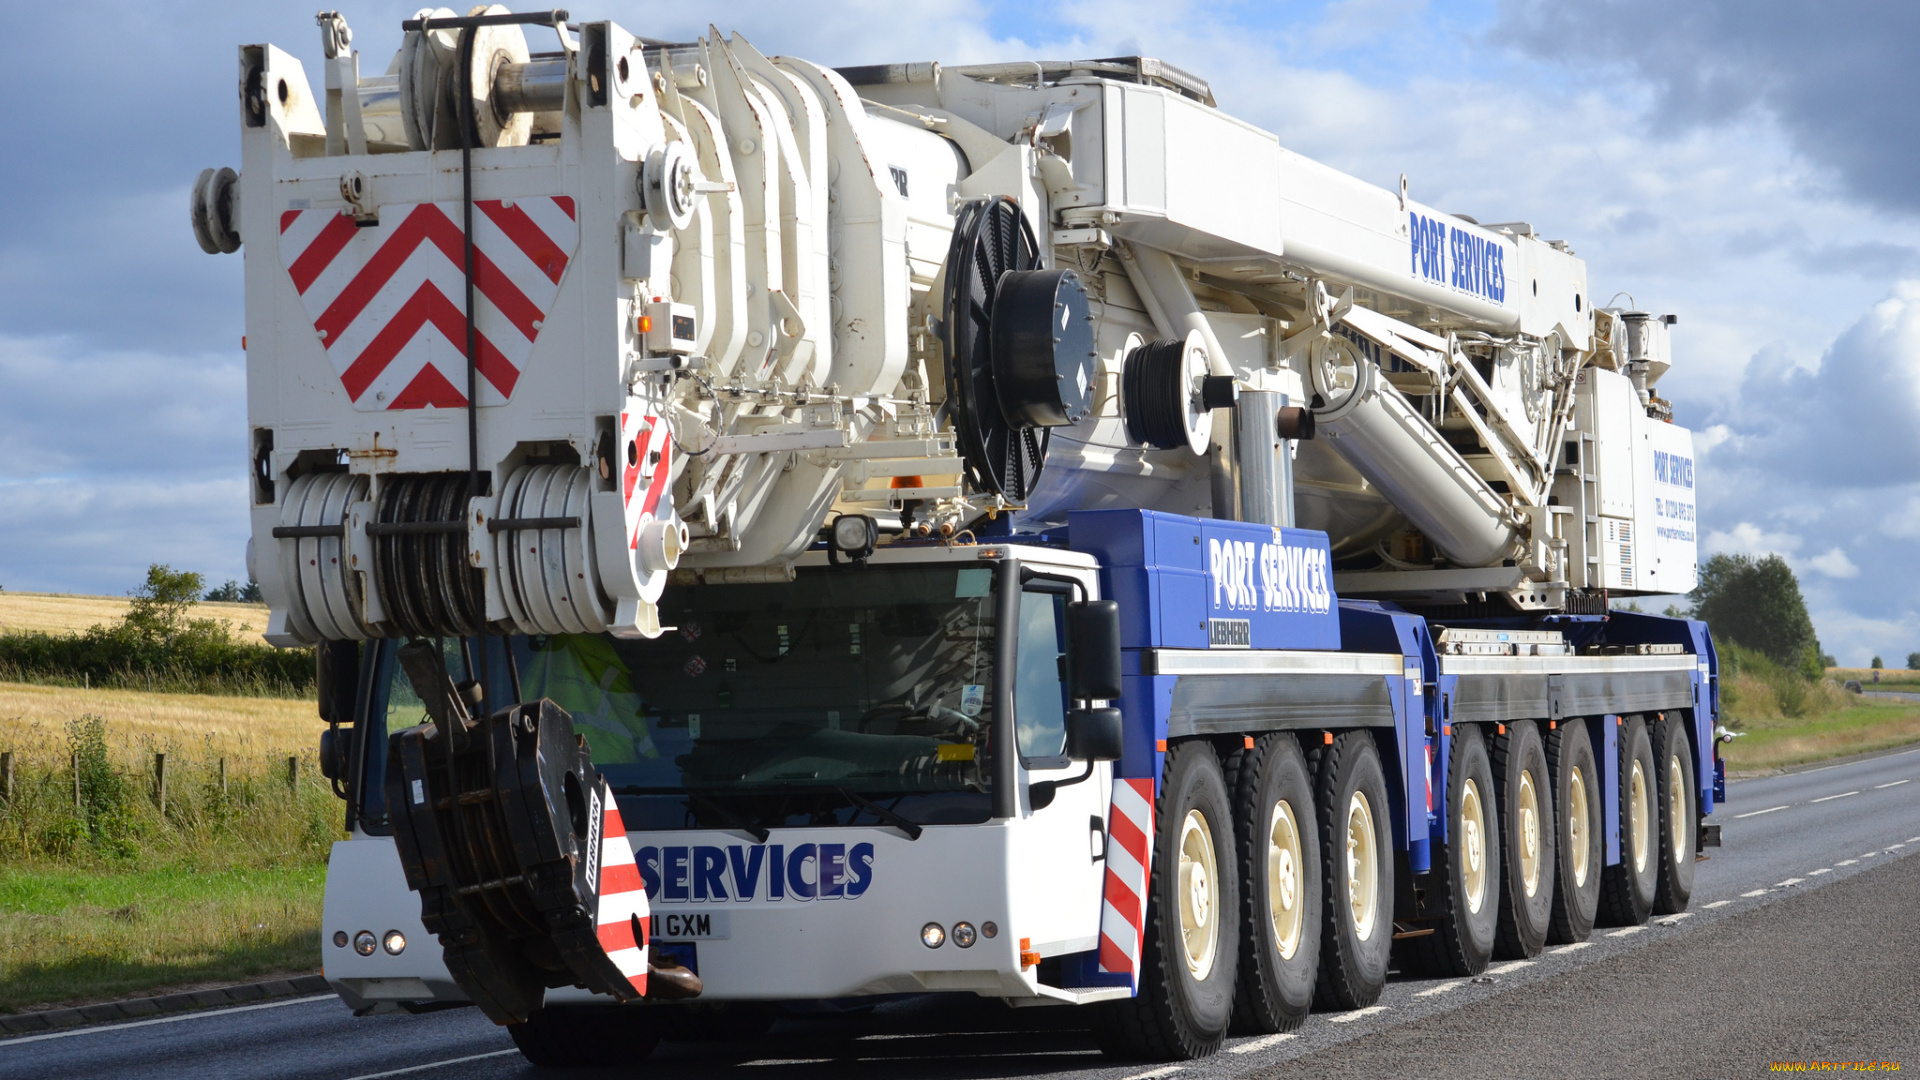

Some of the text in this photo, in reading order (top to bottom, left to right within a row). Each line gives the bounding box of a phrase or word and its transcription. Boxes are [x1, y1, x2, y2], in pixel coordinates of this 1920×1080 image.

[1410, 211, 1506, 308] PORT SERVICES
[1654, 450, 1693, 489] PORT SERVICES
[1209, 538, 1331, 615] PORT SERVICES
[1209, 619, 1250, 647] LIEBHERR
[587, 795, 600, 887] LIEBHERR
[634, 842, 874, 903] SERVICES
[666, 914, 711, 937] GXM
